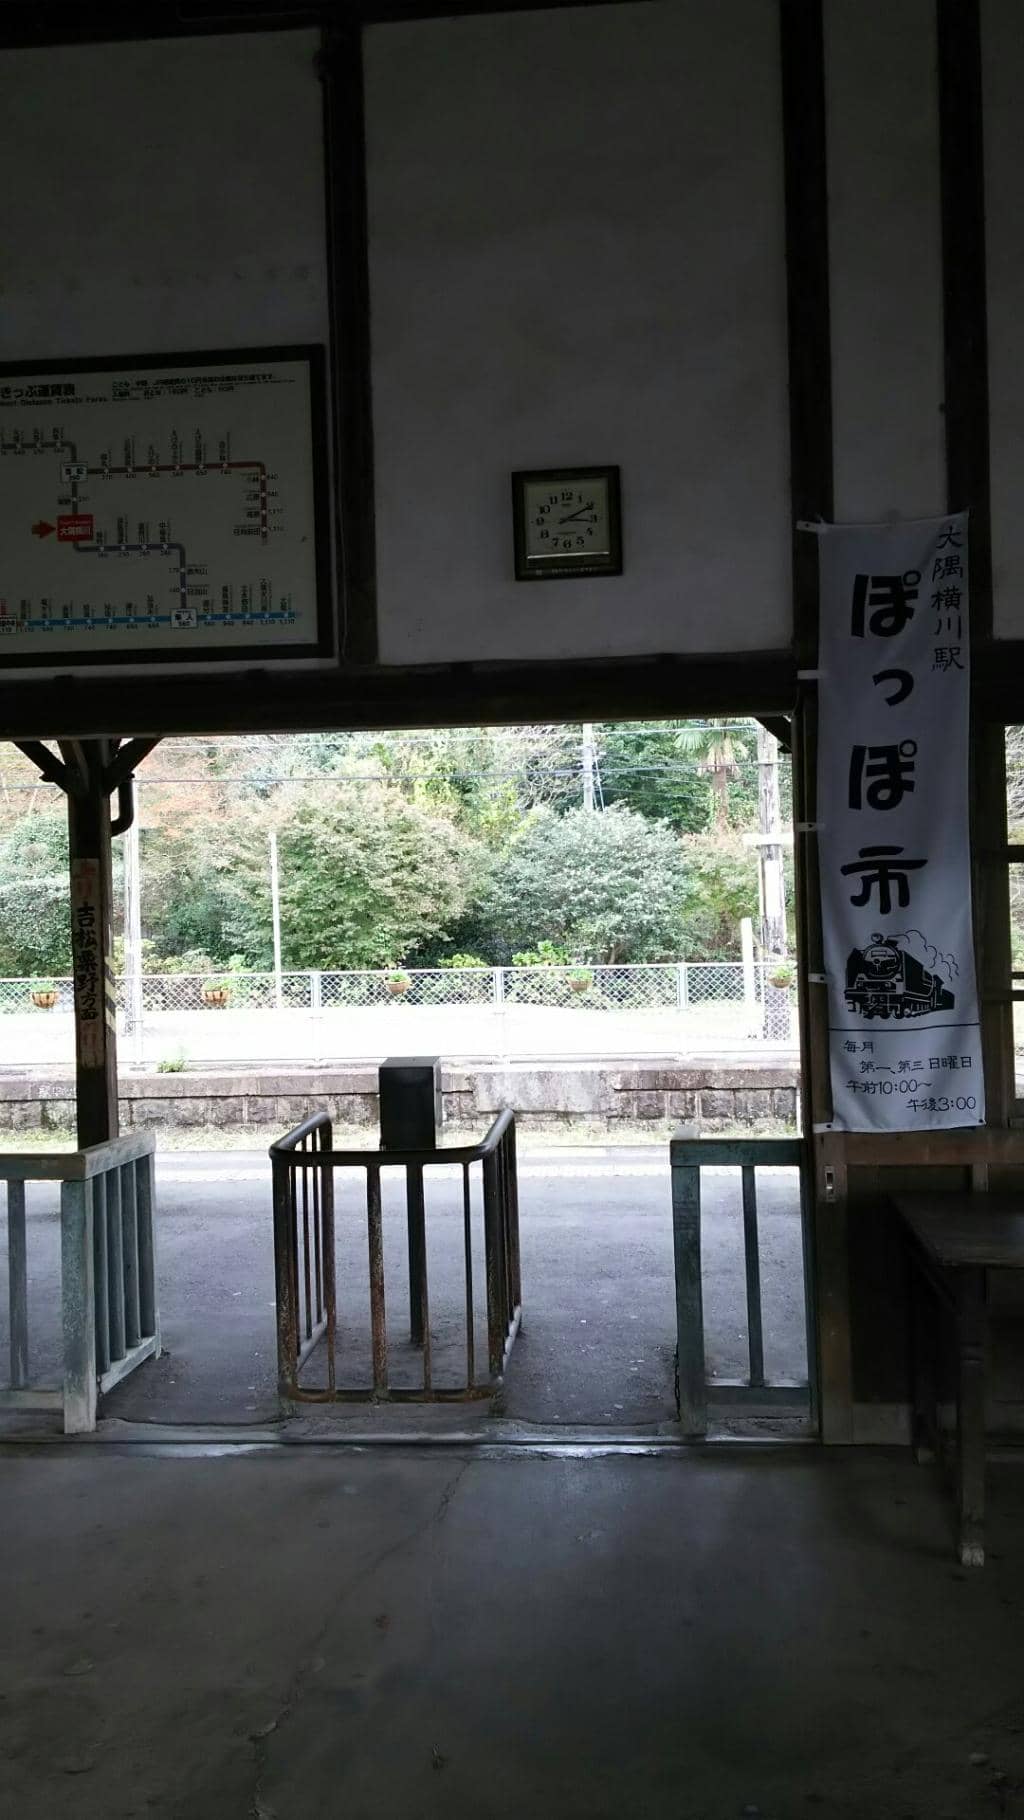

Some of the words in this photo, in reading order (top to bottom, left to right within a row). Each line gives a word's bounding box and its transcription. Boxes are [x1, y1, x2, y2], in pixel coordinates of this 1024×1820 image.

[549, 495, 558, 505] 11
[561, 491, 573, 501] 12
[539, 505, 551, 514] 10
[551, 538, 559, 547] 7
[563, 539, 572, 549] 6
[931, 525, 965, 673] 大隅横川駅
[841, 569, 928, 915] ぽっぽ市
[844, 1040, 875, 1055] 毎月
[906, 1096, 977, 1113] 午後3:00
